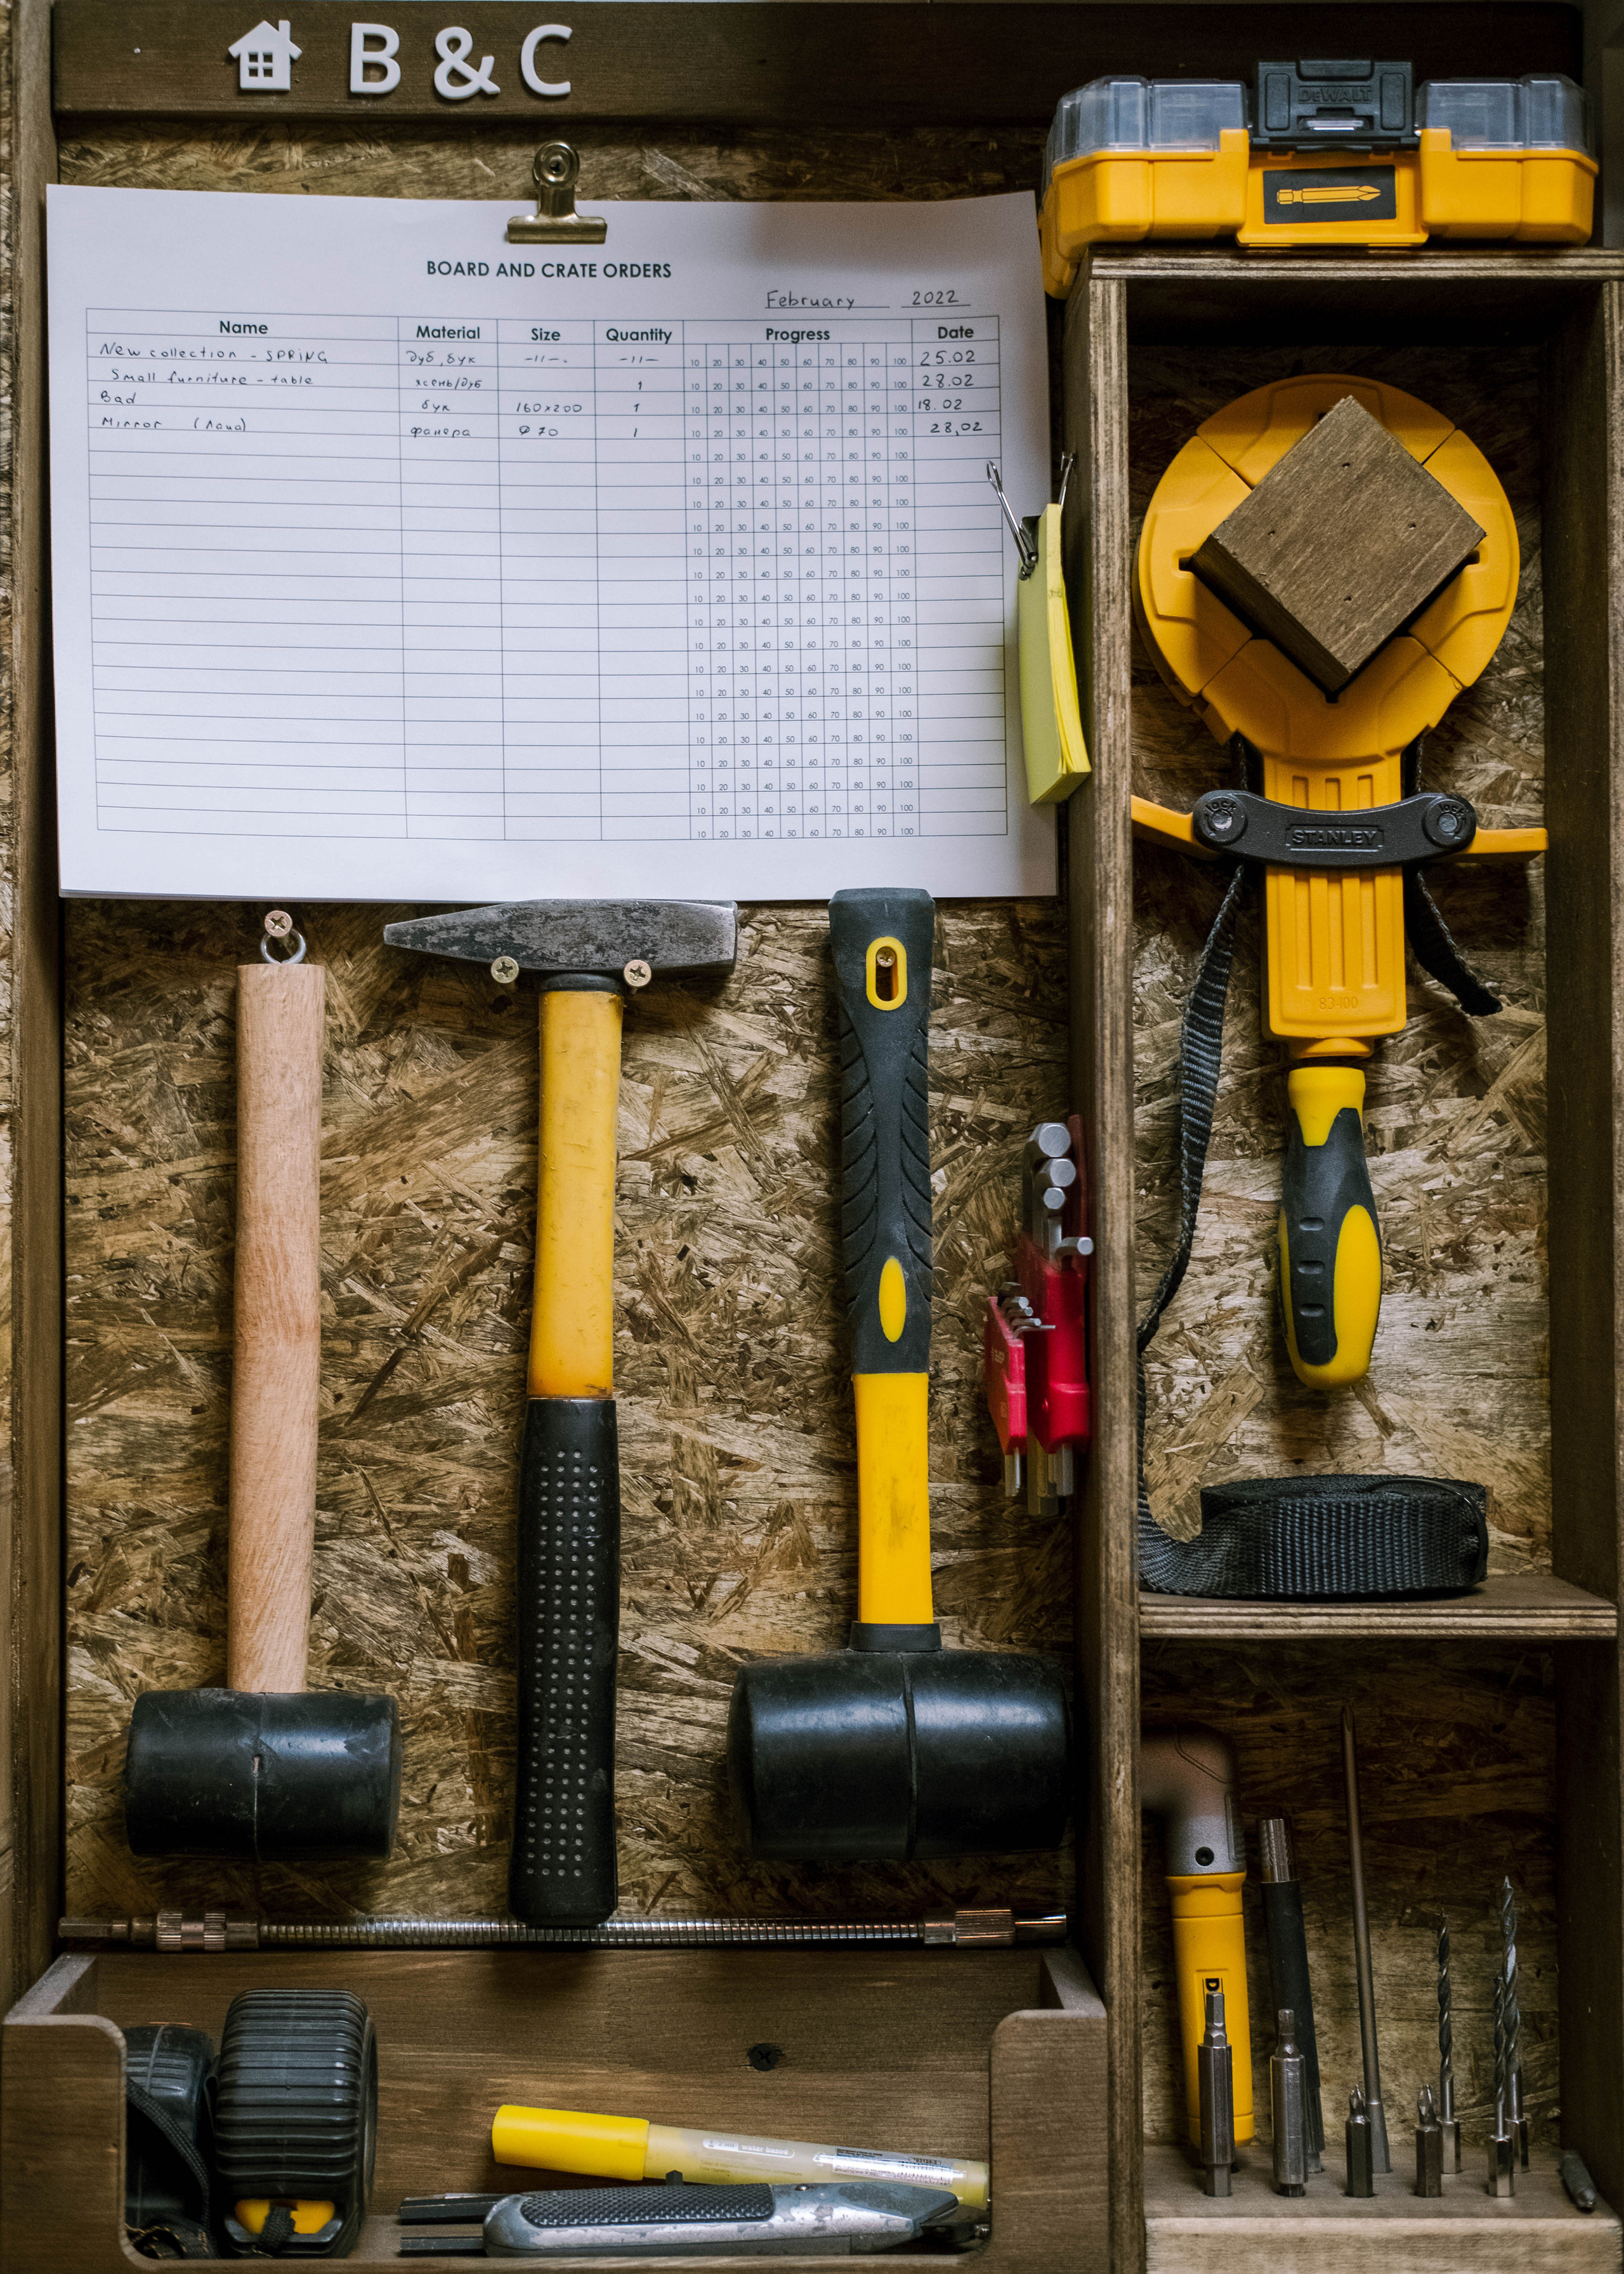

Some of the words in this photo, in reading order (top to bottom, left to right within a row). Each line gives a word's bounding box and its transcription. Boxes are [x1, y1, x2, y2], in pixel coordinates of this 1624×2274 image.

[350, 23, 401, 94] B
[435, 26, 500, 100] &
[521, 24, 573, 96] C
[427, 261, 489, 275] BOARD
[496, 263, 535, 277] AND
[541, 263, 597, 277] CRATE
[603, 263, 671, 278] ORDERS
[766, 290, 855, 310] February
[912, 290, 960, 306] 2022
[219, 320, 268, 335] Name
[416, 325, 480, 340] Material
[531, 327, 561, 341] Size
[938, 326, 974, 339] Date
[606, 327, 672, 345] Quantity
[766, 327, 830, 343] Progress
[99, 342, 141, 357] New
[150, 347, 237, 358] collection
[691, 359, 700, 367] 10
[735, 358, 745, 367] 30
[757, 358, 767, 367] 40
[825, 358, 835, 366] 70
[847, 358, 857, 366] 80
[870, 358, 880, 366] 90
[893, 357, 907, 365] 100
[920, 350, 976, 367] 25.02
[112, 368, 156, 383] Small
[168, 371, 249, 385] furniture
[271, 374, 314, 384] table
[922, 373, 974, 388] 28.02
[100, 390, 136, 405] Bad
[691, 406, 700, 414] 10
[713, 406, 723, 414] 20
[758, 405, 768, 414] 40
[780, 405, 790, 414] 50
[826, 405, 835, 413] 70
[848, 405, 858, 413] 80
[894, 404, 908, 412] 100
[102, 416, 162, 429] Mirror
[714, 476, 724, 485] 20
[782, 476, 792, 484] 50
[804, 476, 814, 484] 60
[849, 475, 859, 483] 80
[693, 524, 702, 532] 10
[737, 523, 747, 532] 30
[805, 523, 815, 531] 60
[896, 522, 910, 530] 100
[716, 595, 726, 603] 20
[738, 595, 748, 603] 30
[761, 594, 771, 602] 40
[897, 592, 910, 600] 100
[738, 641, 749, 650] 30
[783, 641, 794, 649] 50
[898, 639, 911, 647] 100
[695, 713, 705, 721] 10
[875, 710, 885, 718] 90
[763, 782, 773, 791] 40
[809, 782, 818, 790] 60
[853, 781, 863, 789] 80
[900, 780, 914, 789] 100
[719, 830, 730, 838] 20
[742, 830, 752, 838] 30
[854, 828, 865, 836] 80
[1291, 828, 1378, 847] STANLEY
[1319, 996, 1358, 1010] 83-100
[741, 2144, 764, 2152] water
[766, 2146, 789, 2155] based
